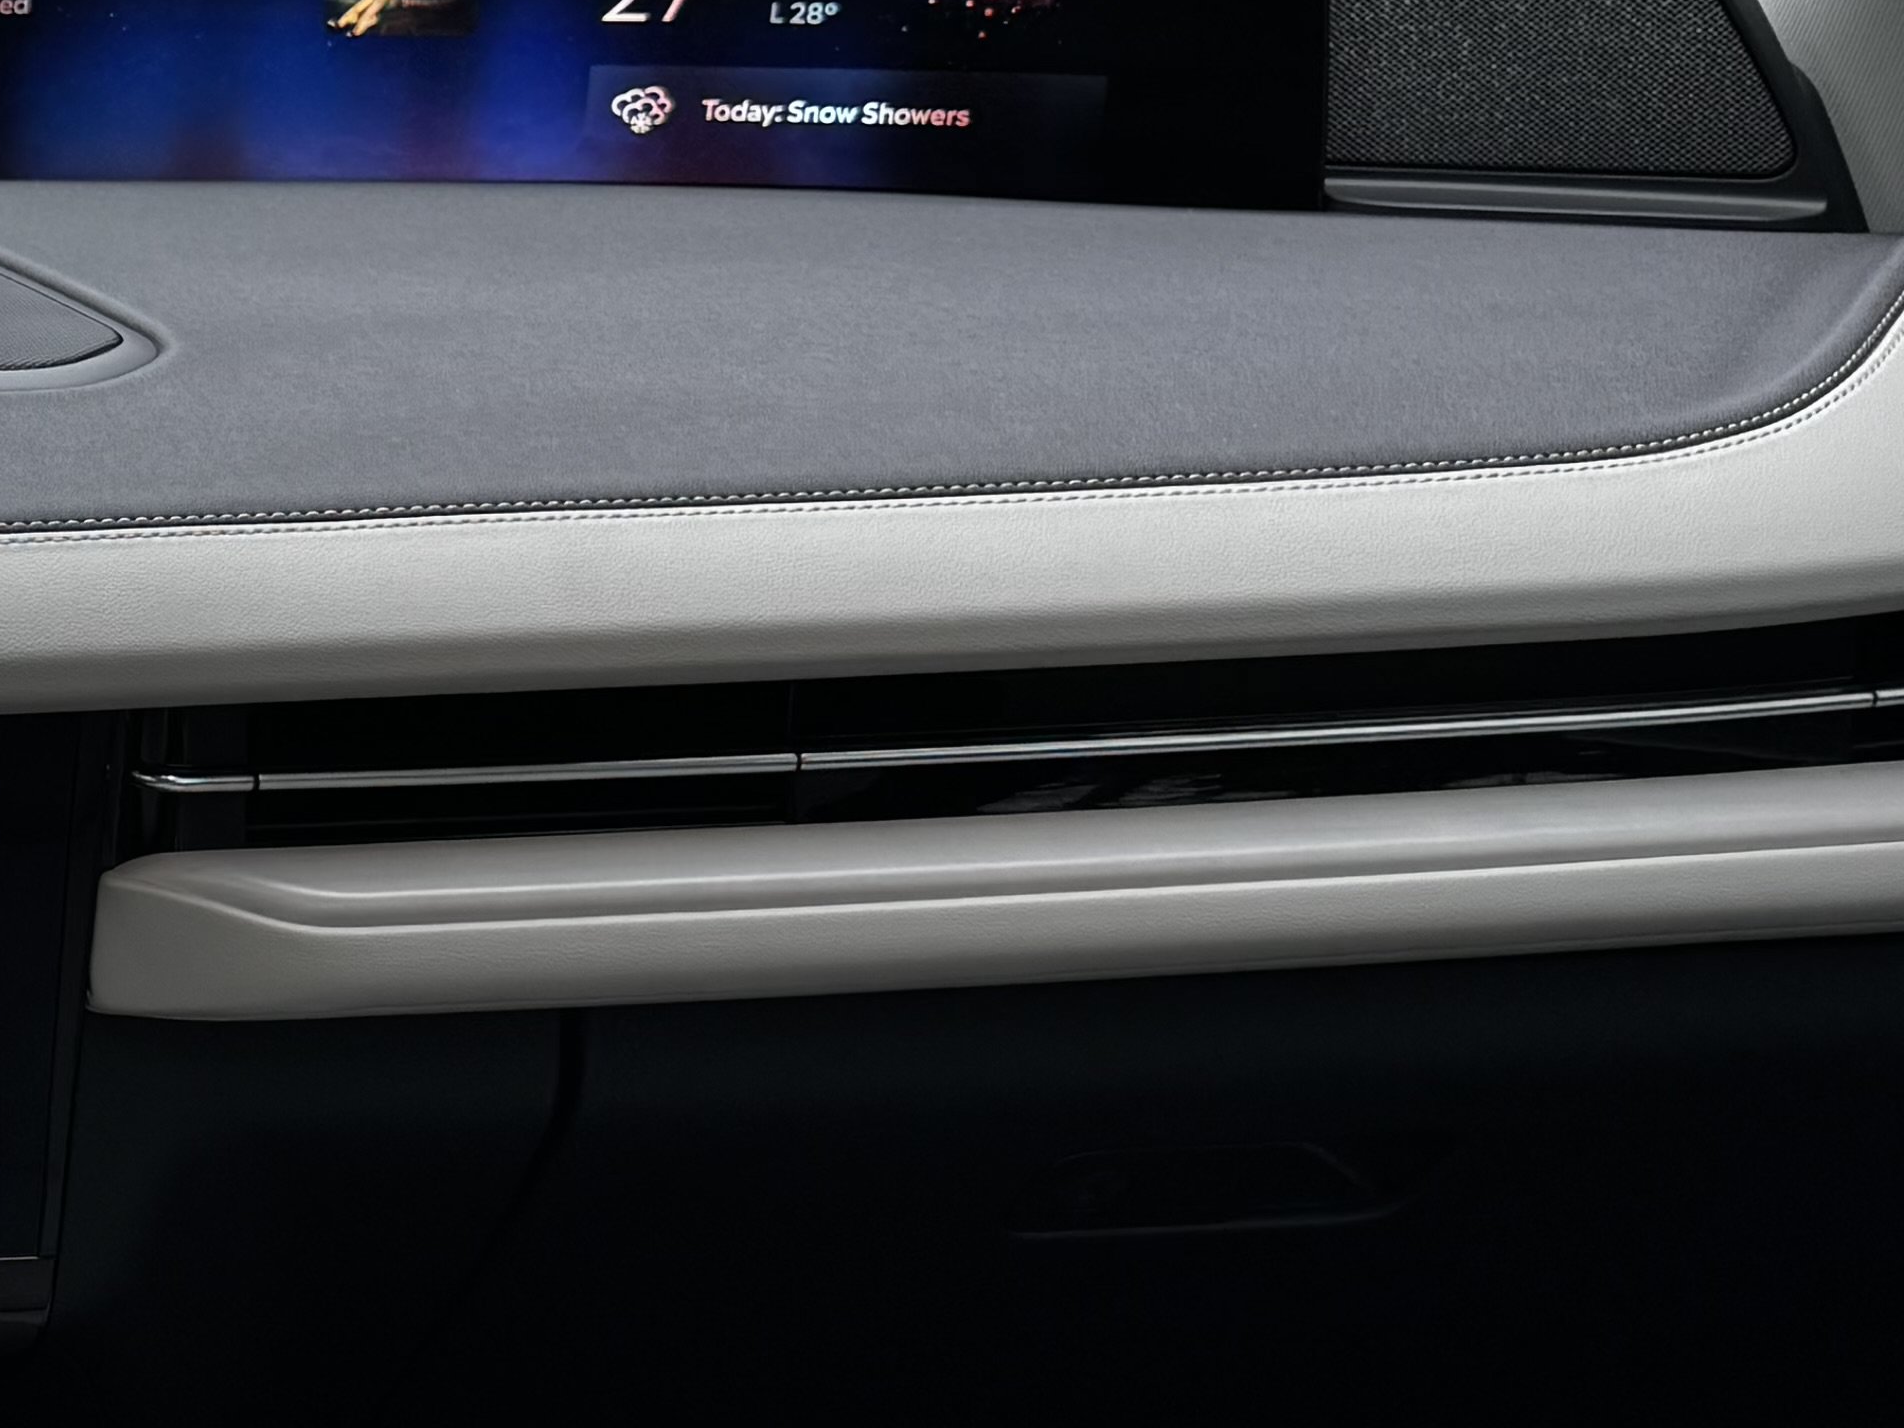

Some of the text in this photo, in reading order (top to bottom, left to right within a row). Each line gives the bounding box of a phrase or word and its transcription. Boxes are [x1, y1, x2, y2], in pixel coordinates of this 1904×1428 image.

[769, 1, 841, 25] L 28°
[701, 99, 971, 128] Today: Snow Showers
